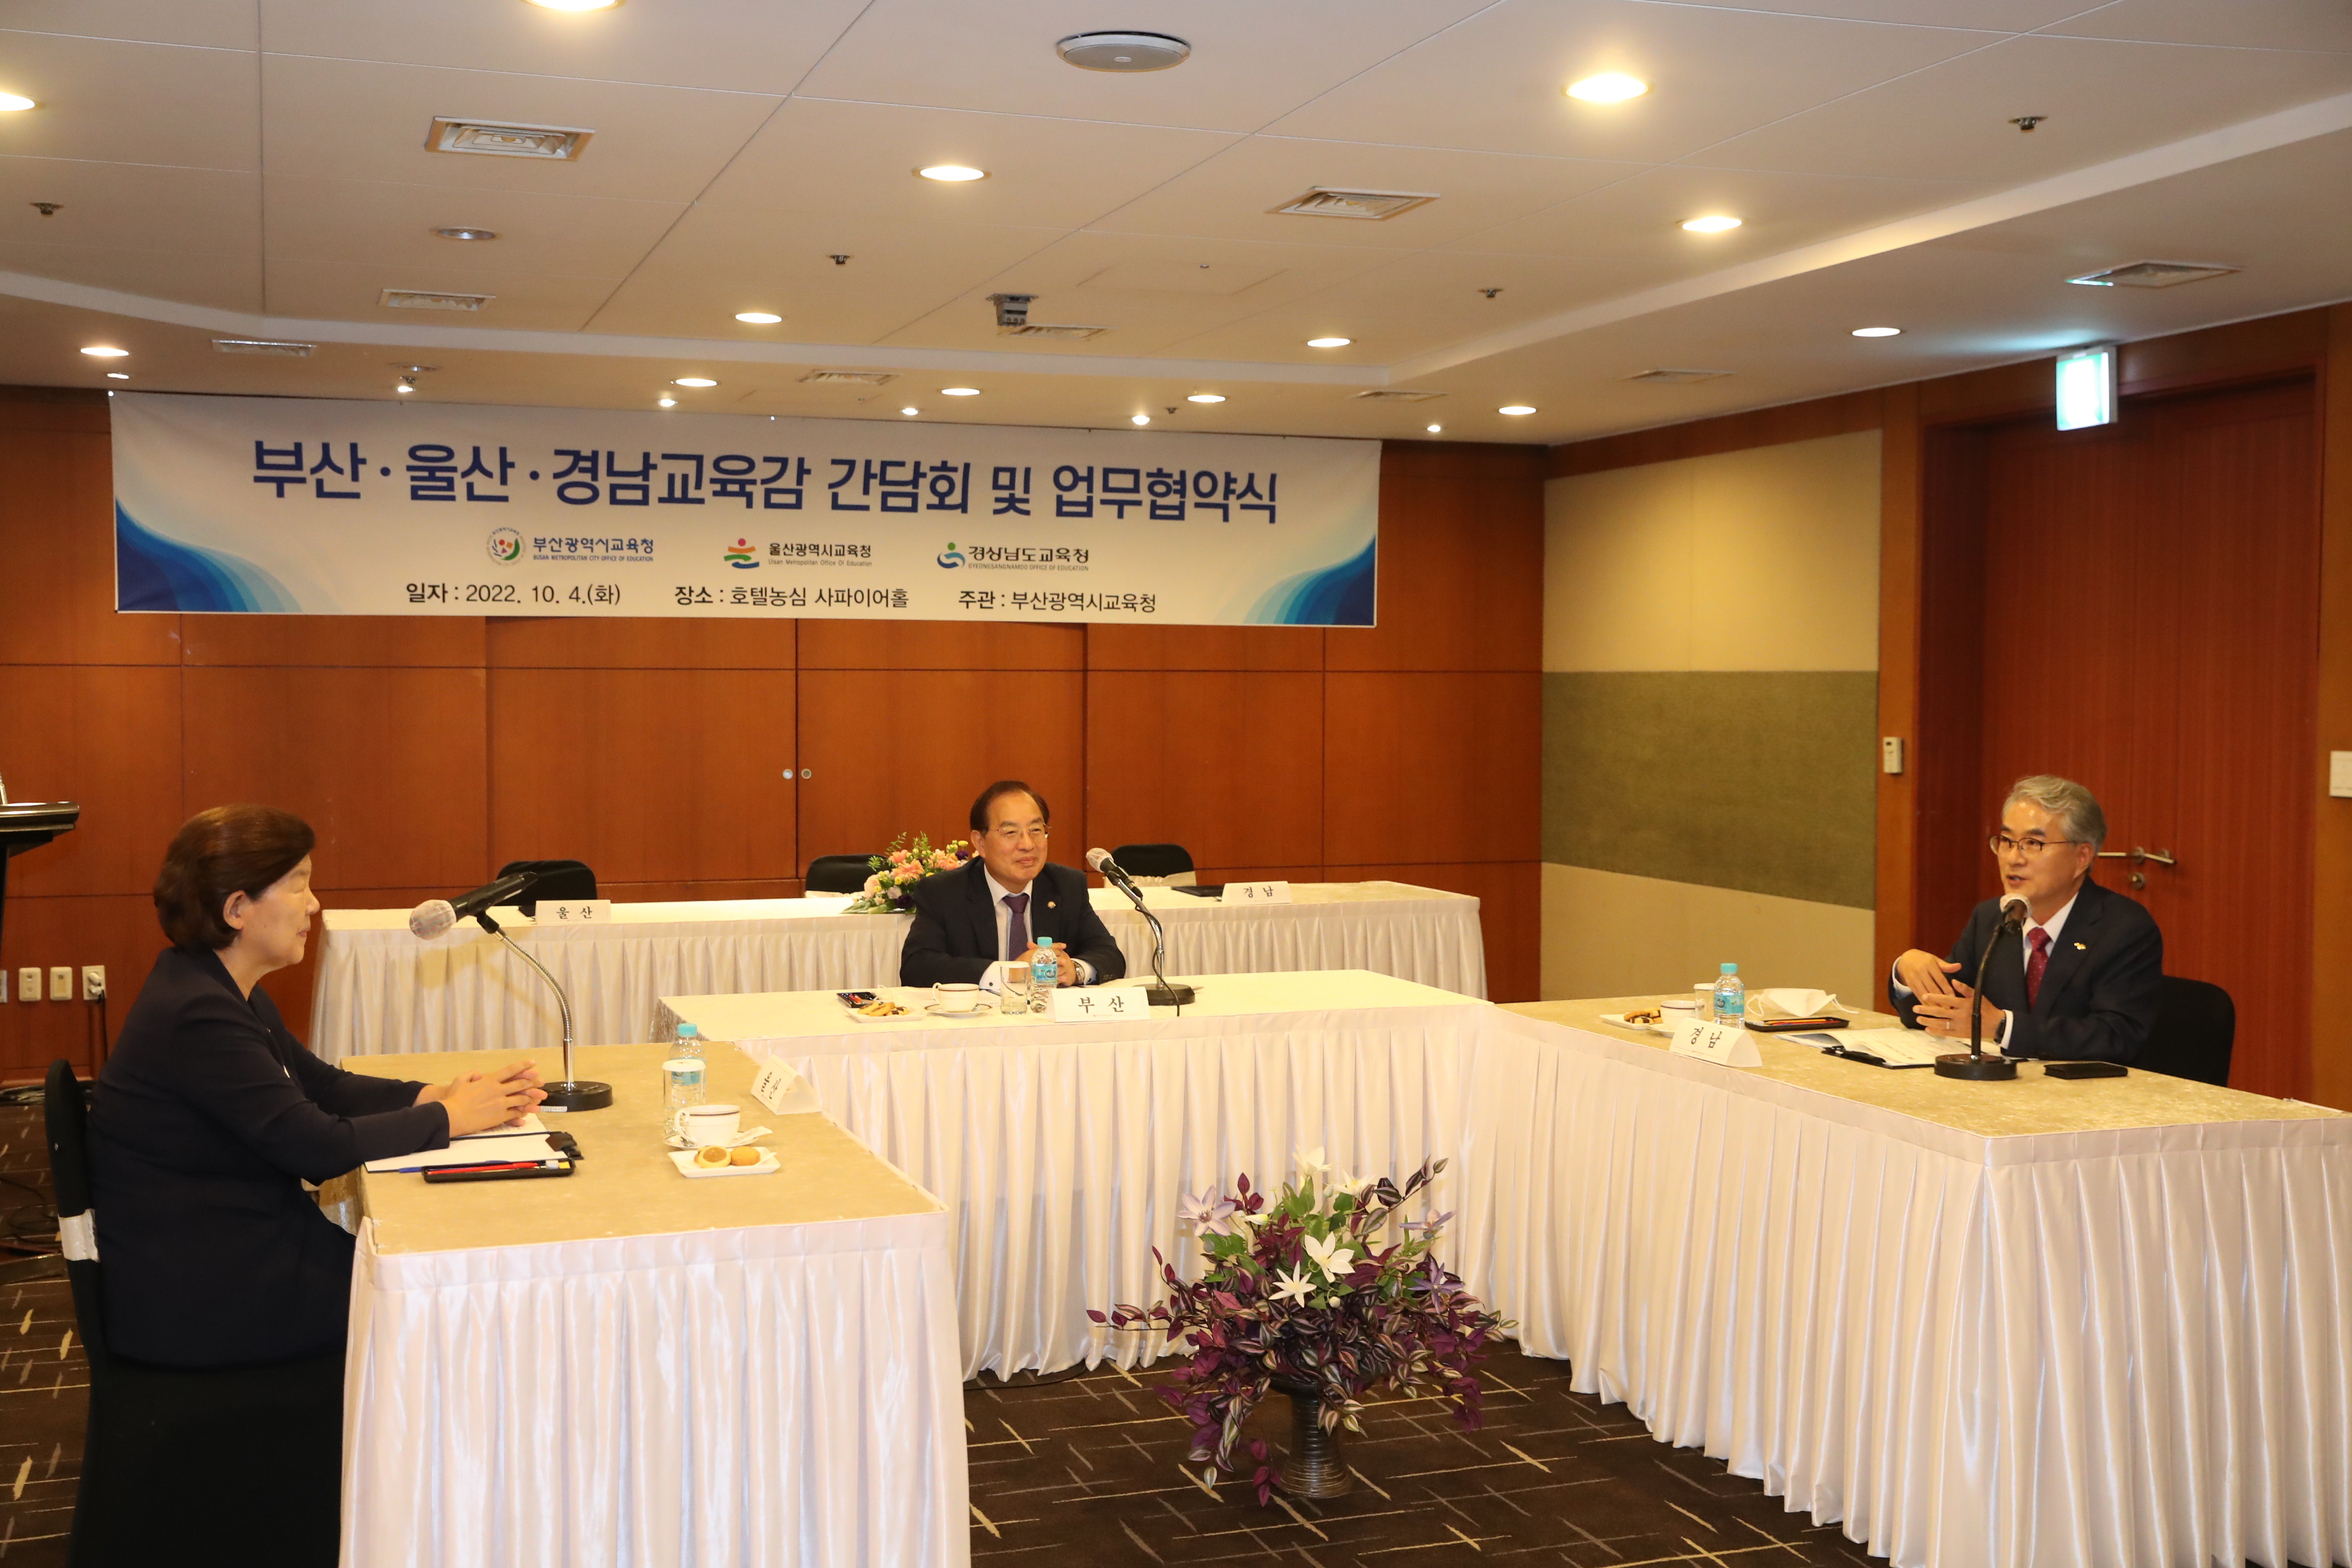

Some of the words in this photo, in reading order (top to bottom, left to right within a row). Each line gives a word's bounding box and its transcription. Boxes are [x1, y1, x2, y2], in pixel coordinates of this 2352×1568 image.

[828, 458, 970, 514] 간담회
[992, 467, 1032, 516] 및
[1053, 465, 1277, 524] 업무협약식
[533, 536, 654, 554] 부산광역시교육청
[769, 542, 871, 558] 울산광역시교육청
[968, 546, 1089, 564] 경상남도교육청
[466, 585, 521, 603] 2022.
[532, 585, 560, 603] 10.
[730, 586, 807, 607] 호텔농심
[814, 587, 909, 608] 사파이어홀
[1011, 591, 1156, 613] 부산광역시교육청
